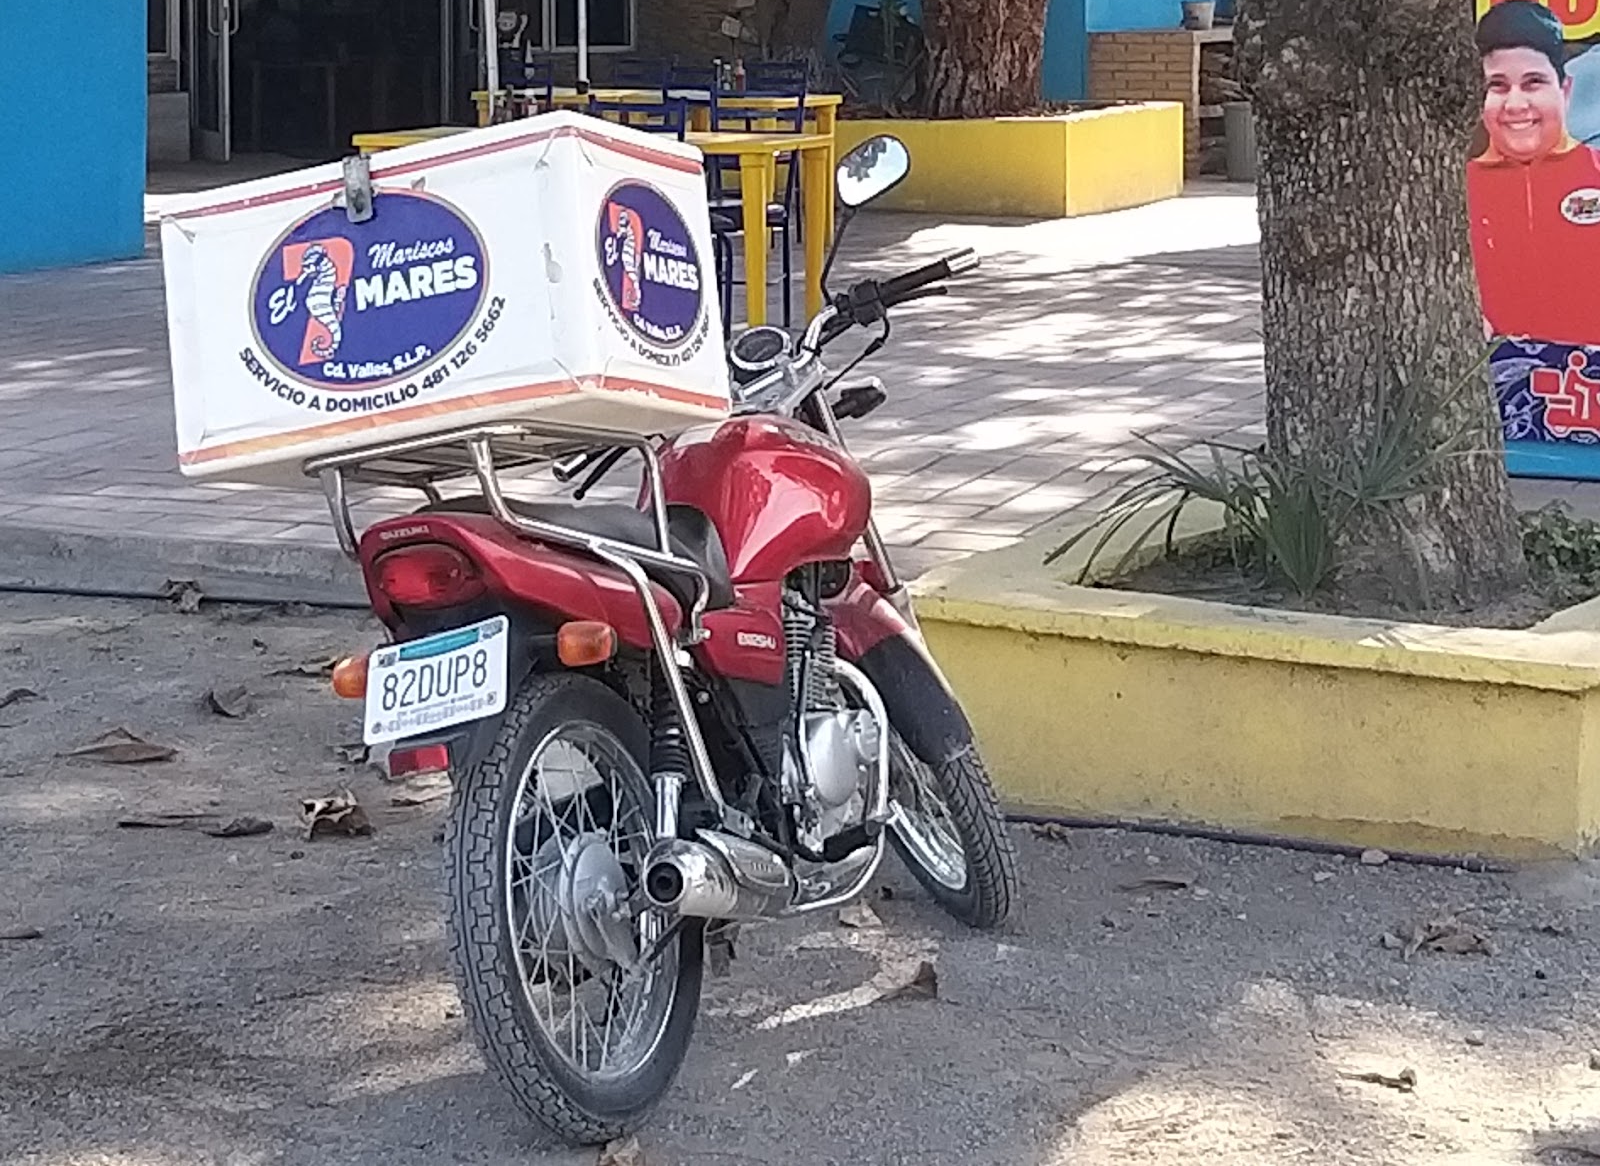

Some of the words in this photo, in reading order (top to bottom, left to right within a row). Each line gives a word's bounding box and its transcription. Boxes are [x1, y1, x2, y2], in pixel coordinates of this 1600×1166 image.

[367, 236, 455, 269] Mariscos
[642, 251, 700, 291] MARES
[268, 287, 297, 324] El
[355, 256, 479, 311] MARES
[239, 346, 307, 406] SERVICIO
[308, 398, 322, 411] A
[325, 386, 420, 413] DOMICILIO
[421, 364, 451, 391] 481
[453, 343, 479, 371] 126
[474, 294, 507, 344] 5662
[379, 524, 430, 541] SUZUKI
[381, 648, 488, 712] 82DUP8
